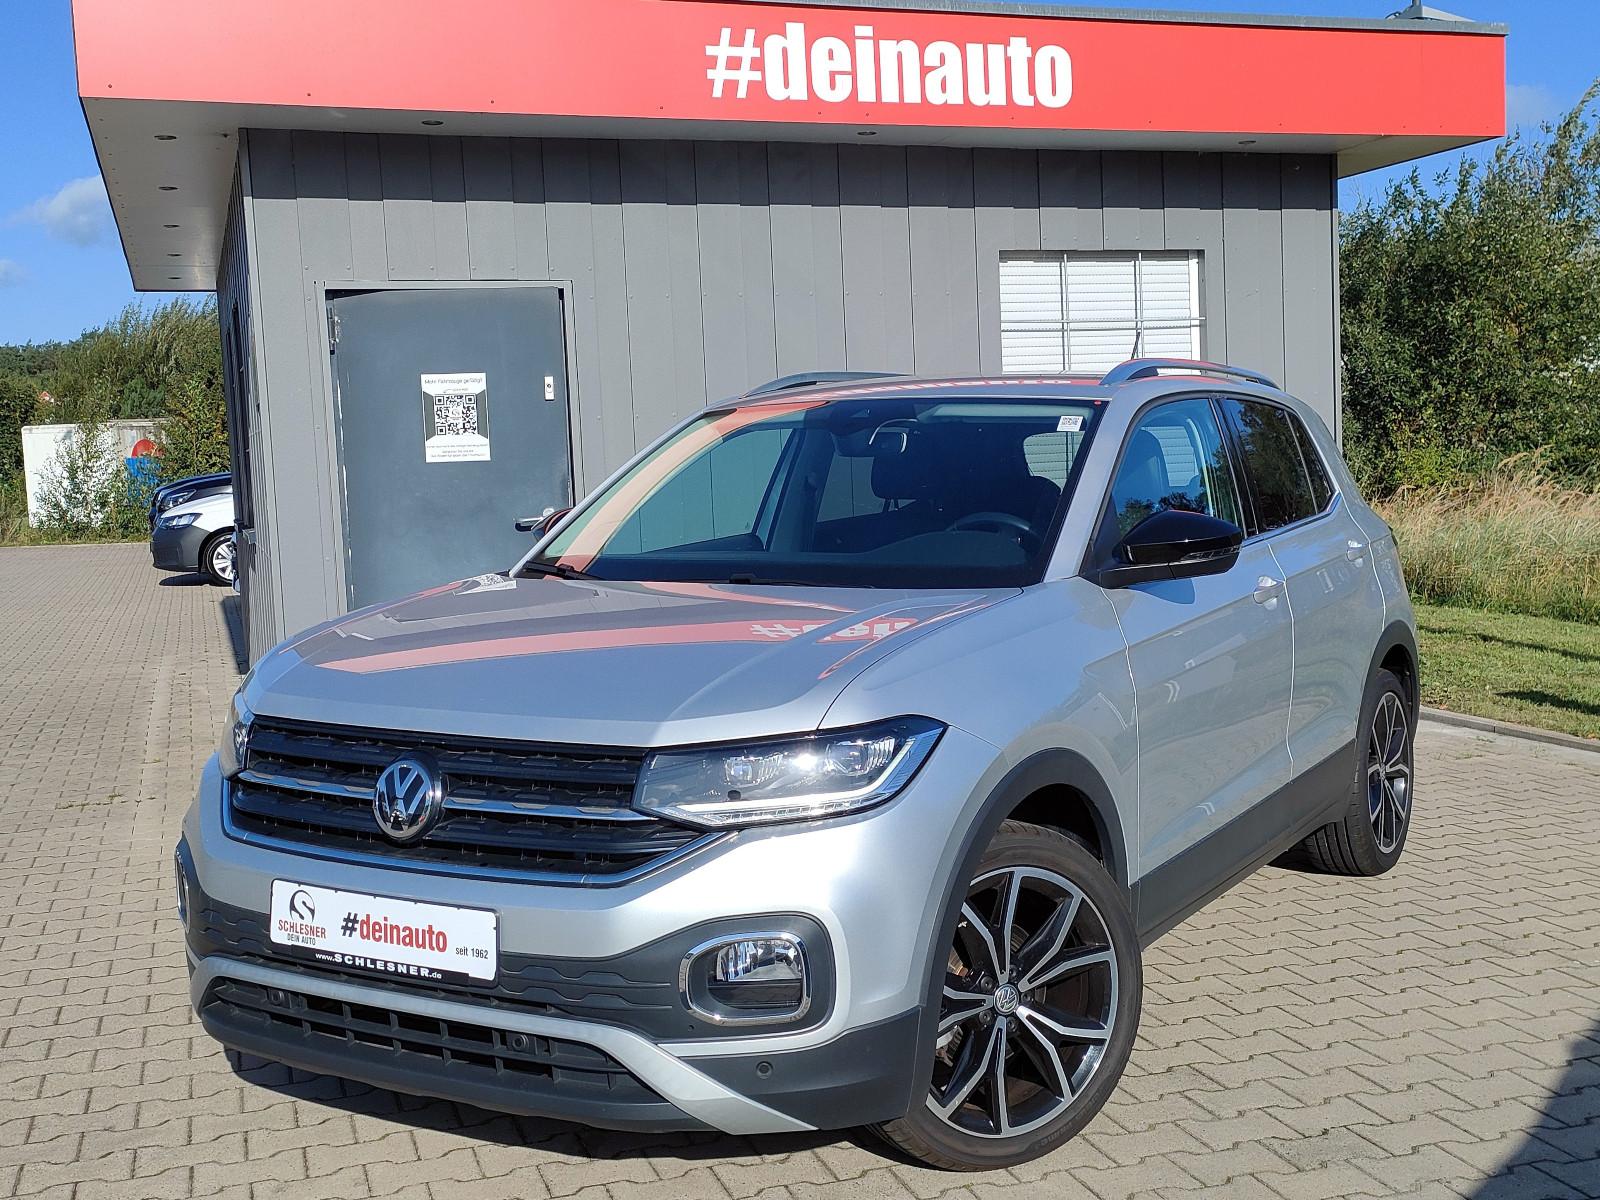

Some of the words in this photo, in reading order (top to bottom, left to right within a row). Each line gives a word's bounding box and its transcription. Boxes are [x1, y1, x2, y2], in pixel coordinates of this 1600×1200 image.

[705, 22, 1073, 108] #deinauto
[278, 919, 327, 939] SCHLESNER
[286, 933, 301, 944] DEIN
[301, 936, 316, 946] AUTO
[341, 911, 448, 953] #deinauto
[455, 946, 469, 957] seit
[471, 947, 489, 960] 1962
[315, 952, 442, 979] www.SCHLESNER.de
